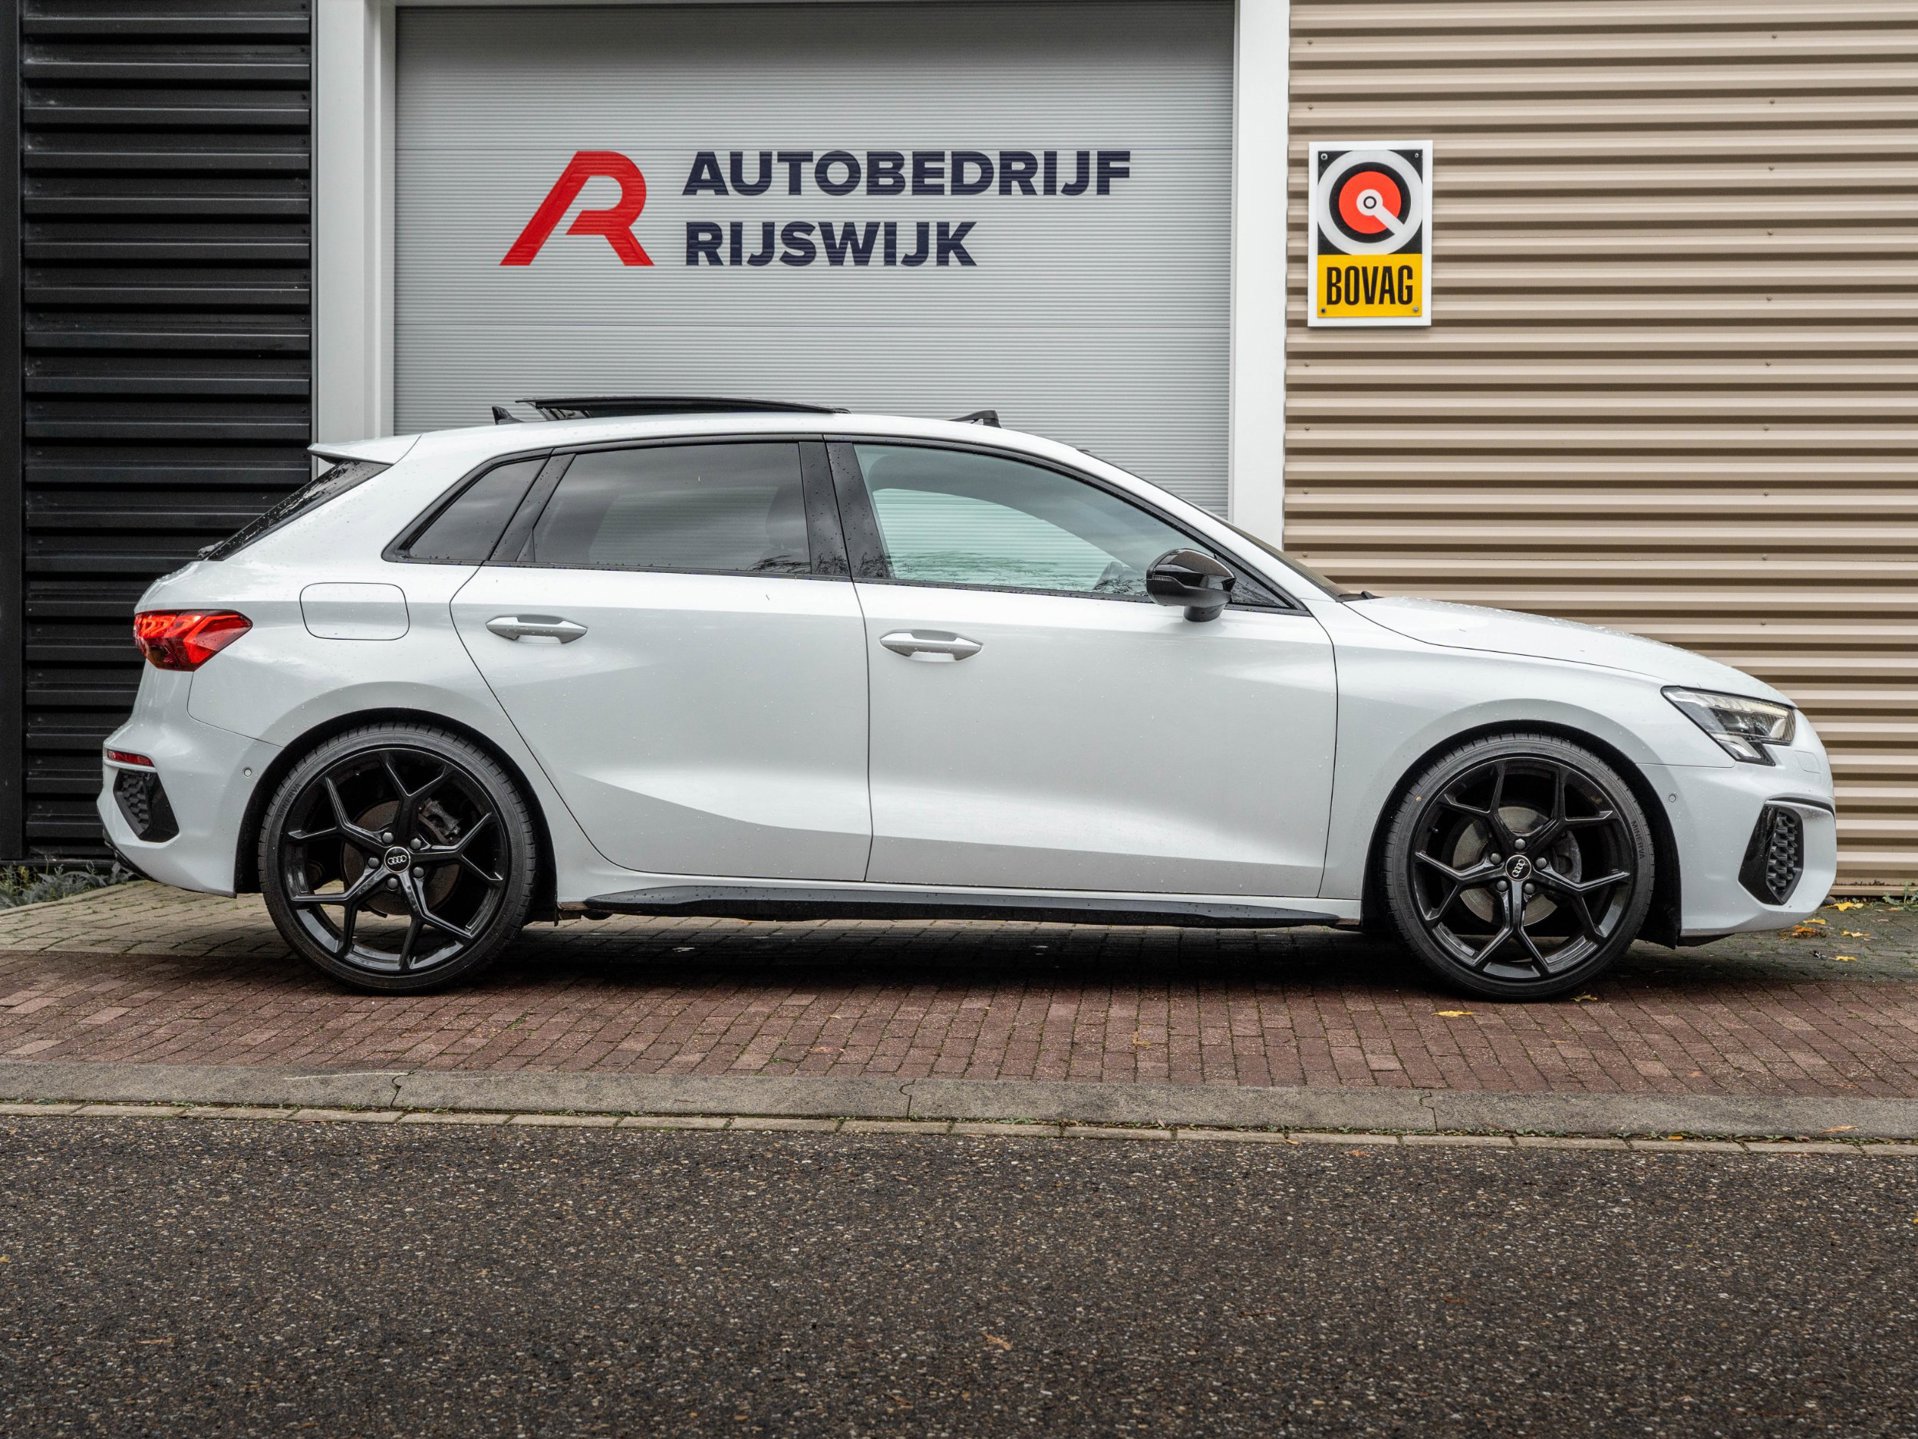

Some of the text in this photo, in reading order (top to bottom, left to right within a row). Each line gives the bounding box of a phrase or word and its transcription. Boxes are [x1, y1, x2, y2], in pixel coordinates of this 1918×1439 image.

[682, 150, 1131, 196] AUTOBEDRIJF
[685, 221, 977, 266] RIJSWIJK
[1326, 265, 1413, 305] BOVAG
[278, 782, 302, 819] MINERVA
[1631, 820, 1645, 860] MINERVA
